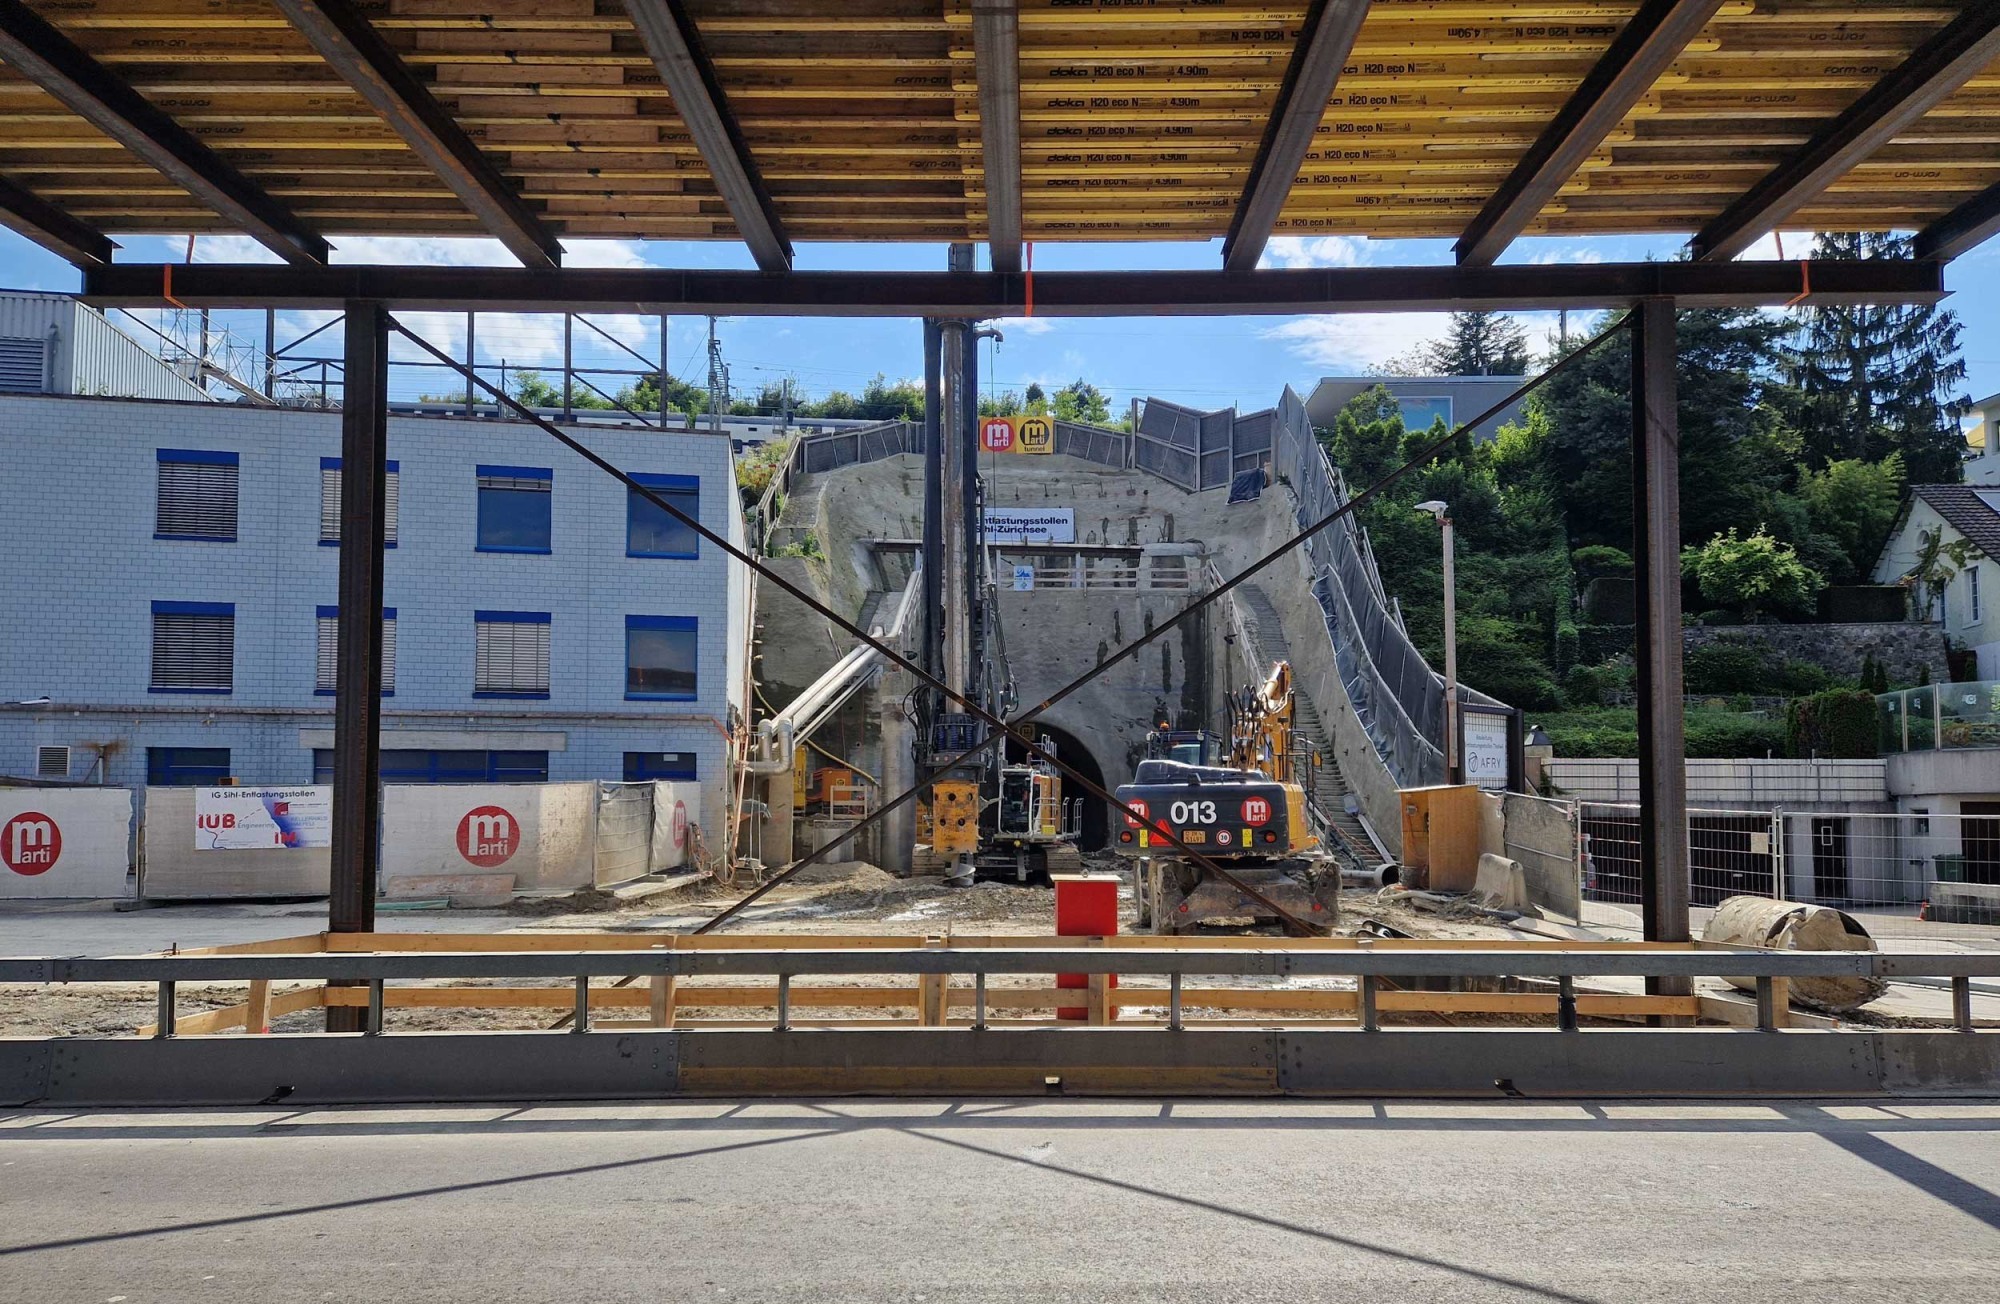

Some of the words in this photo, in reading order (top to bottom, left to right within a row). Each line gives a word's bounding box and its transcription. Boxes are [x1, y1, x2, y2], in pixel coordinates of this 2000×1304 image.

[1232, 32, 1238, 40] N
[1264, 32, 1284, 40] H20
[1516, 28, 1522, 36] N
[1527, 28, 1545, 36] eco
[1549, 28, 1568, 36] H20
[1576, 28, 1616, 36] doka
[1050, 68, 1088, 76] doka
[1094, 66, 1114, 76] H20
[1116, 68, 1135, 76] eco
[1138, 66, 1144, 76] N
[1177, 66, 1208, 76] 4.90m
[1364, 64, 1382, 73] H20
[1386, 65, 1404, 73] eco
[1408, 64, 1416, 73] N
[1048, 99, 1085, 107] doka
[1091, 98, 1108, 107] H20
[1112, 99, 1128, 107] eco
[1132, 98, 1138, 107] N
[1170, 98, 1200, 107] 4.90m
[1349, 96, 1367, 104] H20
[1390, 96, 1398, 104] N
[1336, 124, 1354, 132] H20
[1376, 124, 1383, 132] N
[1048, 154, 1082, 162] doka
[1087, 154, 1104, 162] H20
[1106, 154, 1122, 162] eco
[1124, 154, 1131, 162] N
[1160, 154, 1188, 162] 4.90m
[1325, 151, 1342, 159] H20
[1362, 151, 1370, 159] N
[1314, 175, 1330, 183] H20
[1350, 175, 1356, 183] N
[976, 526, 1048, 534] Shl-Zürichsee
[1480, 758, 1501, 768] AFRY
[224, 790, 316, 799] Sihl-Entlastungsstollen
[1170, 801, 1216, 824] 013
